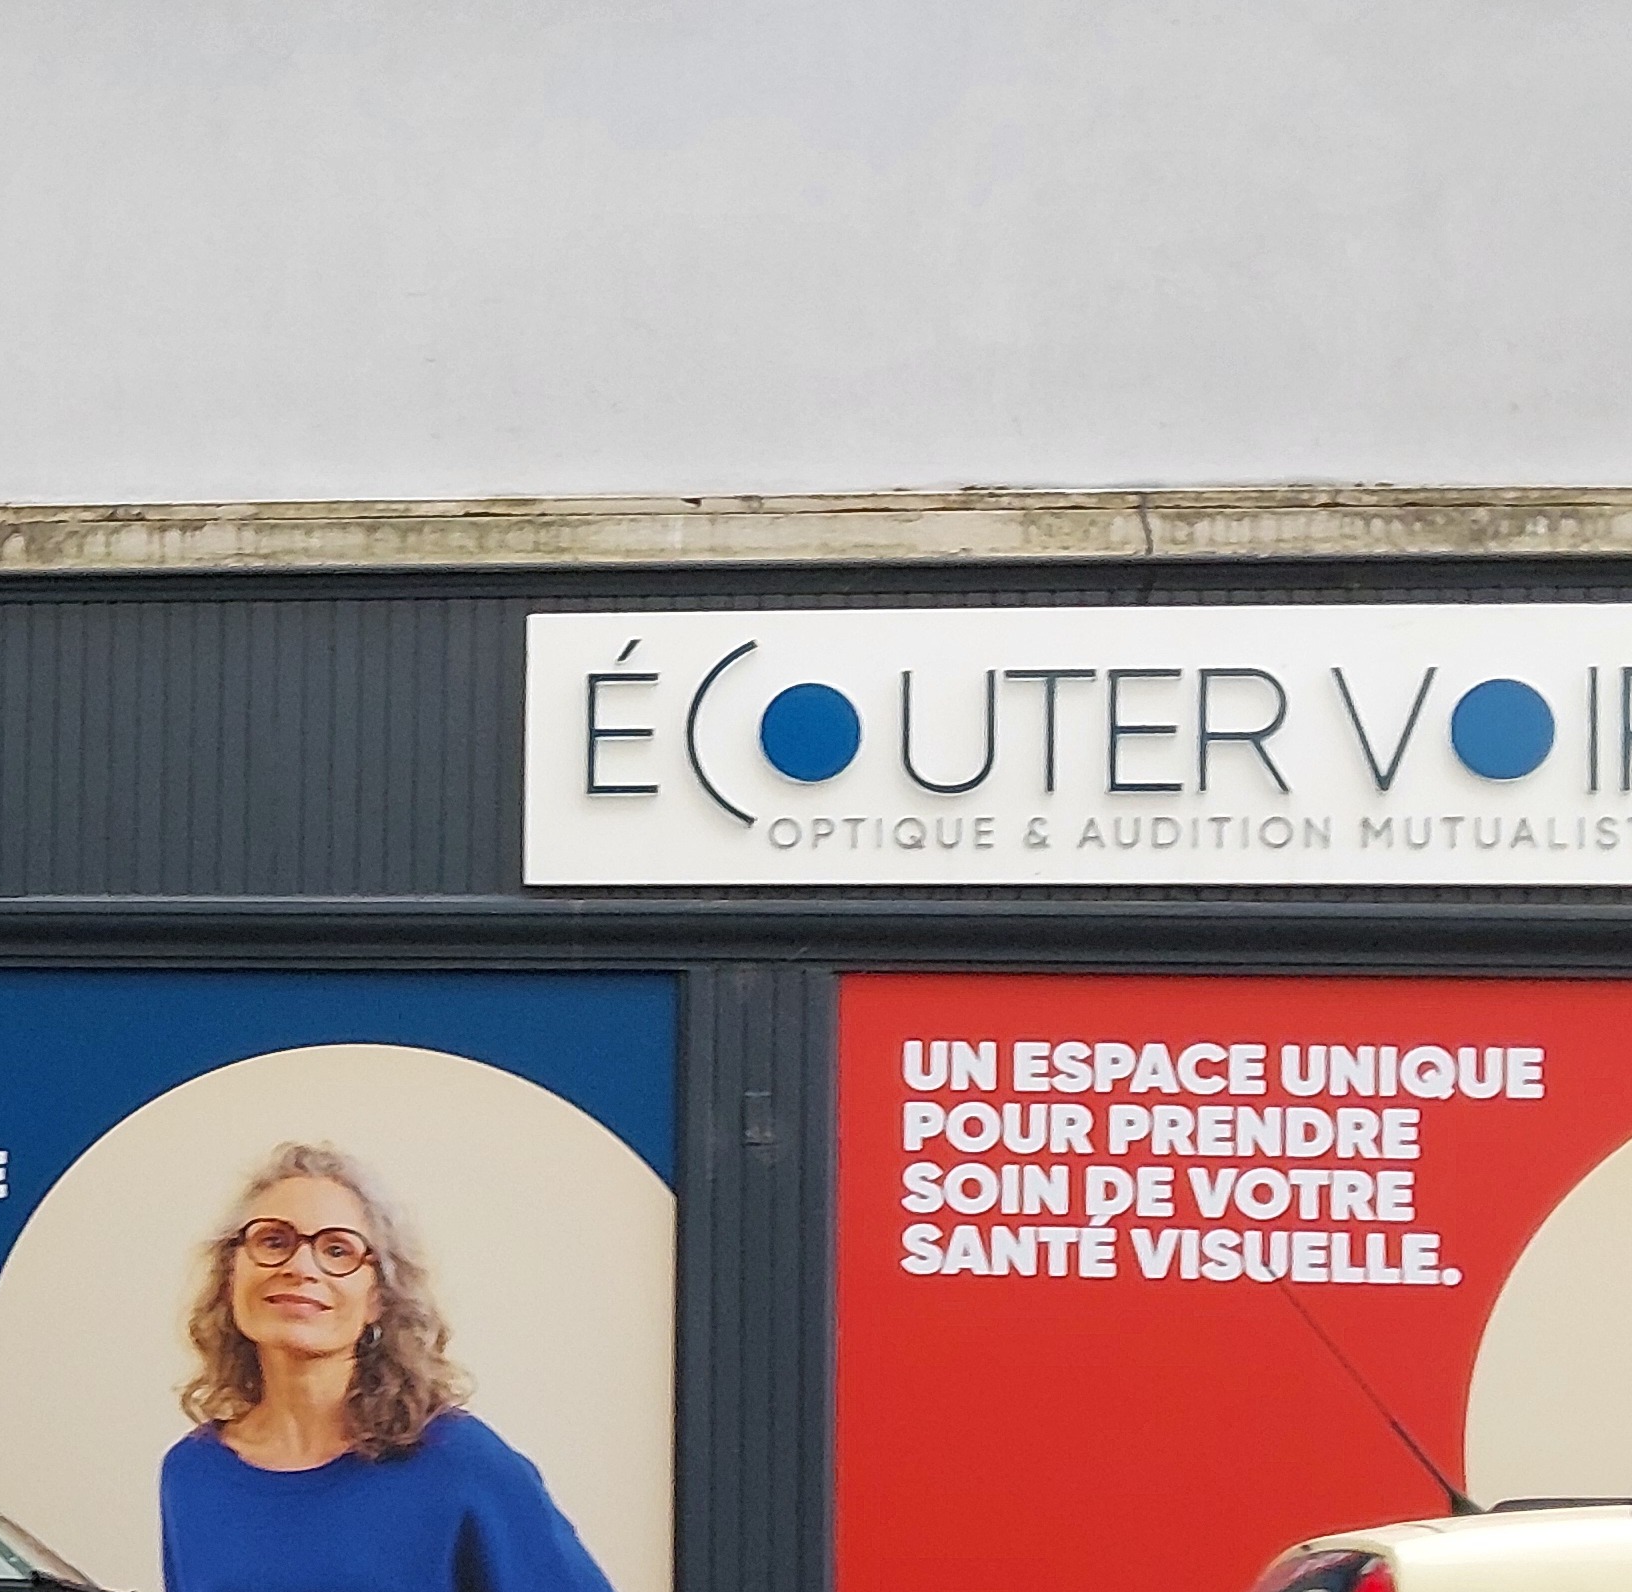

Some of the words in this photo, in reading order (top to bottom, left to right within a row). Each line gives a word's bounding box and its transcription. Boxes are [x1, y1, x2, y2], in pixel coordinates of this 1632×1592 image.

[583, 639, 1291, 827] ÉCOUTER
[767, 815, 996, 853] OPTIQUE
[1024, 816, 1052, 850] &
[1077, 815, 1333, 852] AUDITION
[903, 1040, 997, 1093] UN
[1012, 1041, 1267, 1095] ESPACE
[1280, 1044, 1545, 1099] UNIQUE
[903, 1101, 1094, 1155] POUR
[1108, 1105, 1421, 1159] PRENDRE
[901, 1162, 1069, 1216] SOIN
[1084, 1166, 1175, 1218] DE
[1188, 1168, 1416, 1222] VOTRE
[900, 1215, 1118, 1278] SANTÉ
[1130, 1227, 1463, 1286] VISUELLE.
